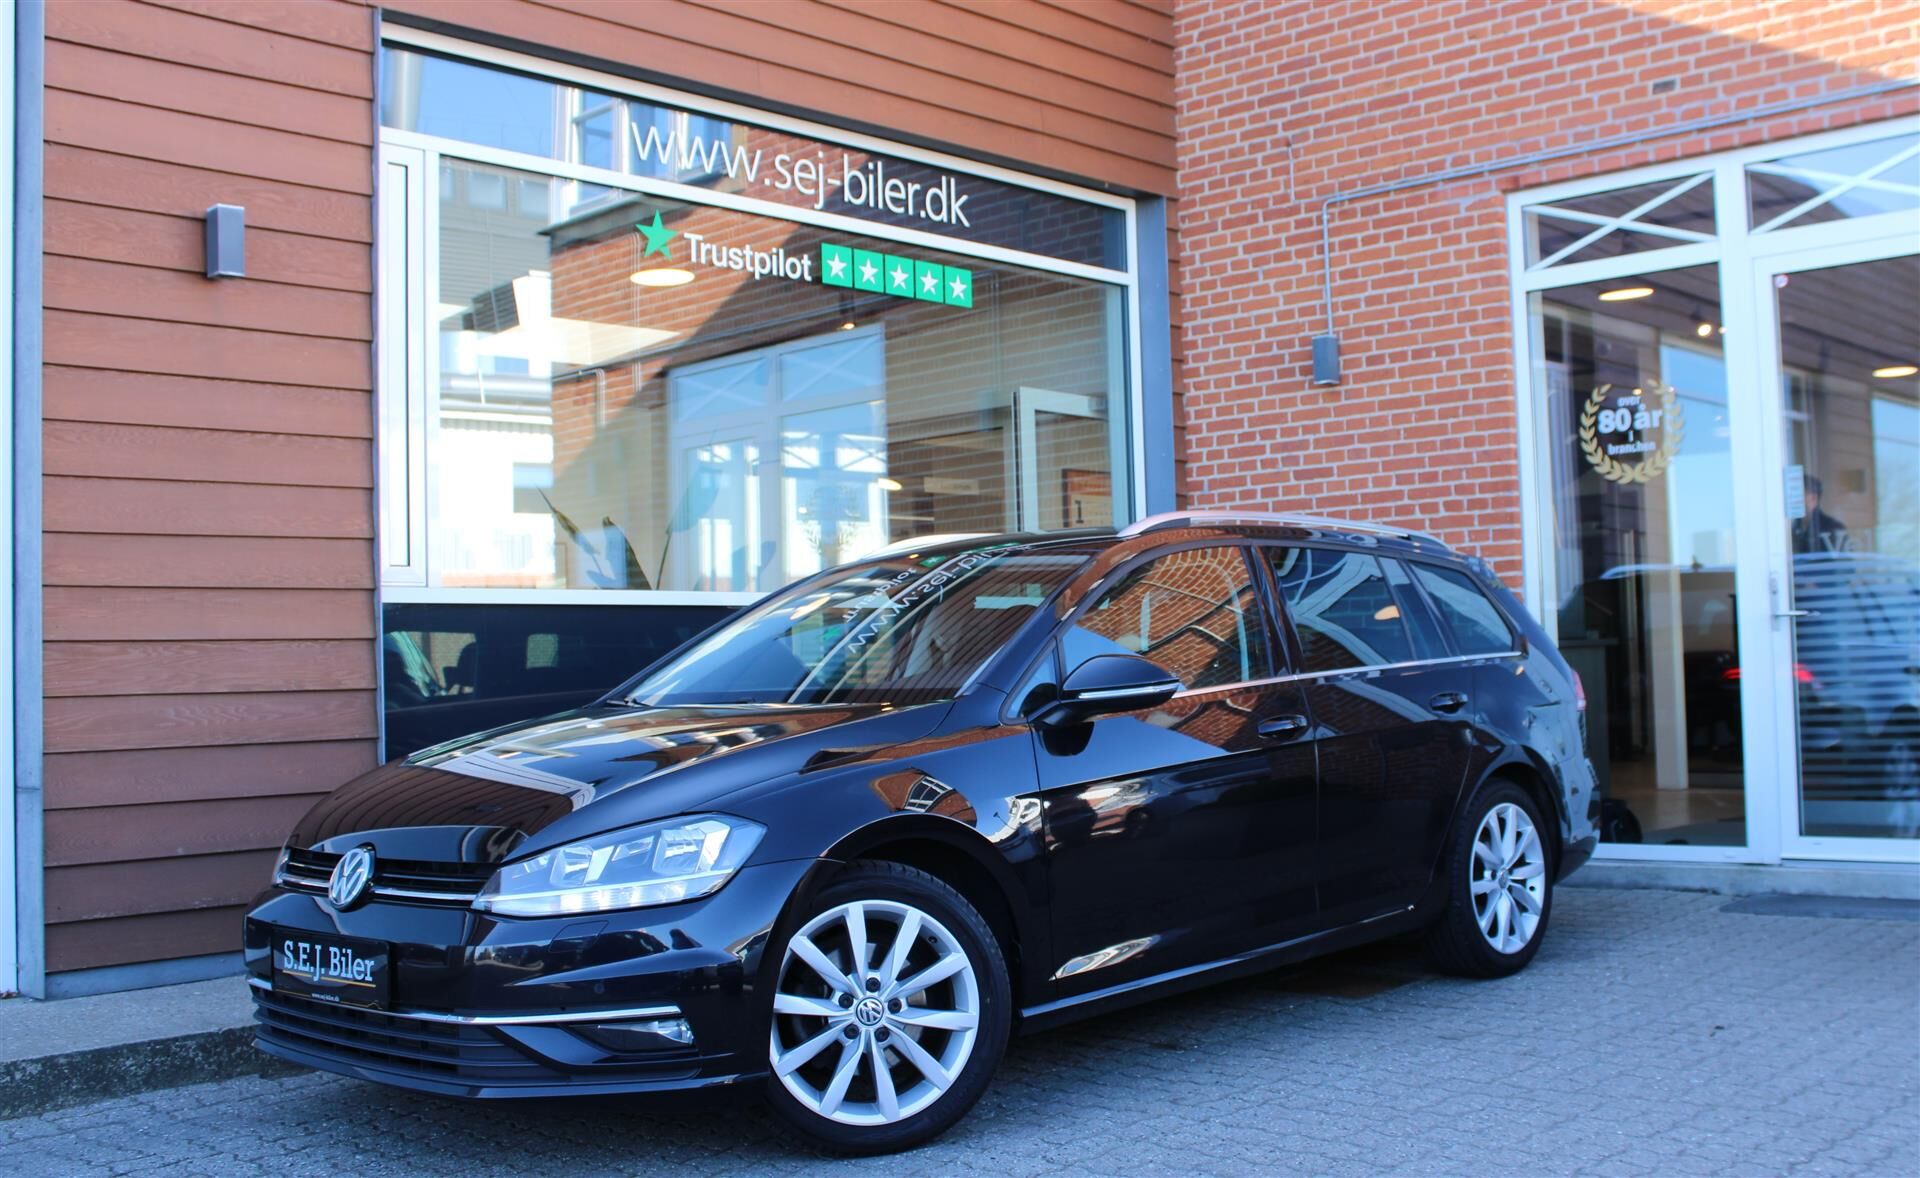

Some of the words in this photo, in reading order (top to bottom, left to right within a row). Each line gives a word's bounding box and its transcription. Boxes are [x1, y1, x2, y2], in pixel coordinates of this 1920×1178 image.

[631, 121, 971, 228] www.sej-biler.dk
[684, 232, 812, 282] Trustpilot
[1598, 408, 1632, 433] 80
[1633, 404, 1662, 430] år
[283, 940, 326, 982] S.E.J.
[329, 947, 375, 982] Biler
